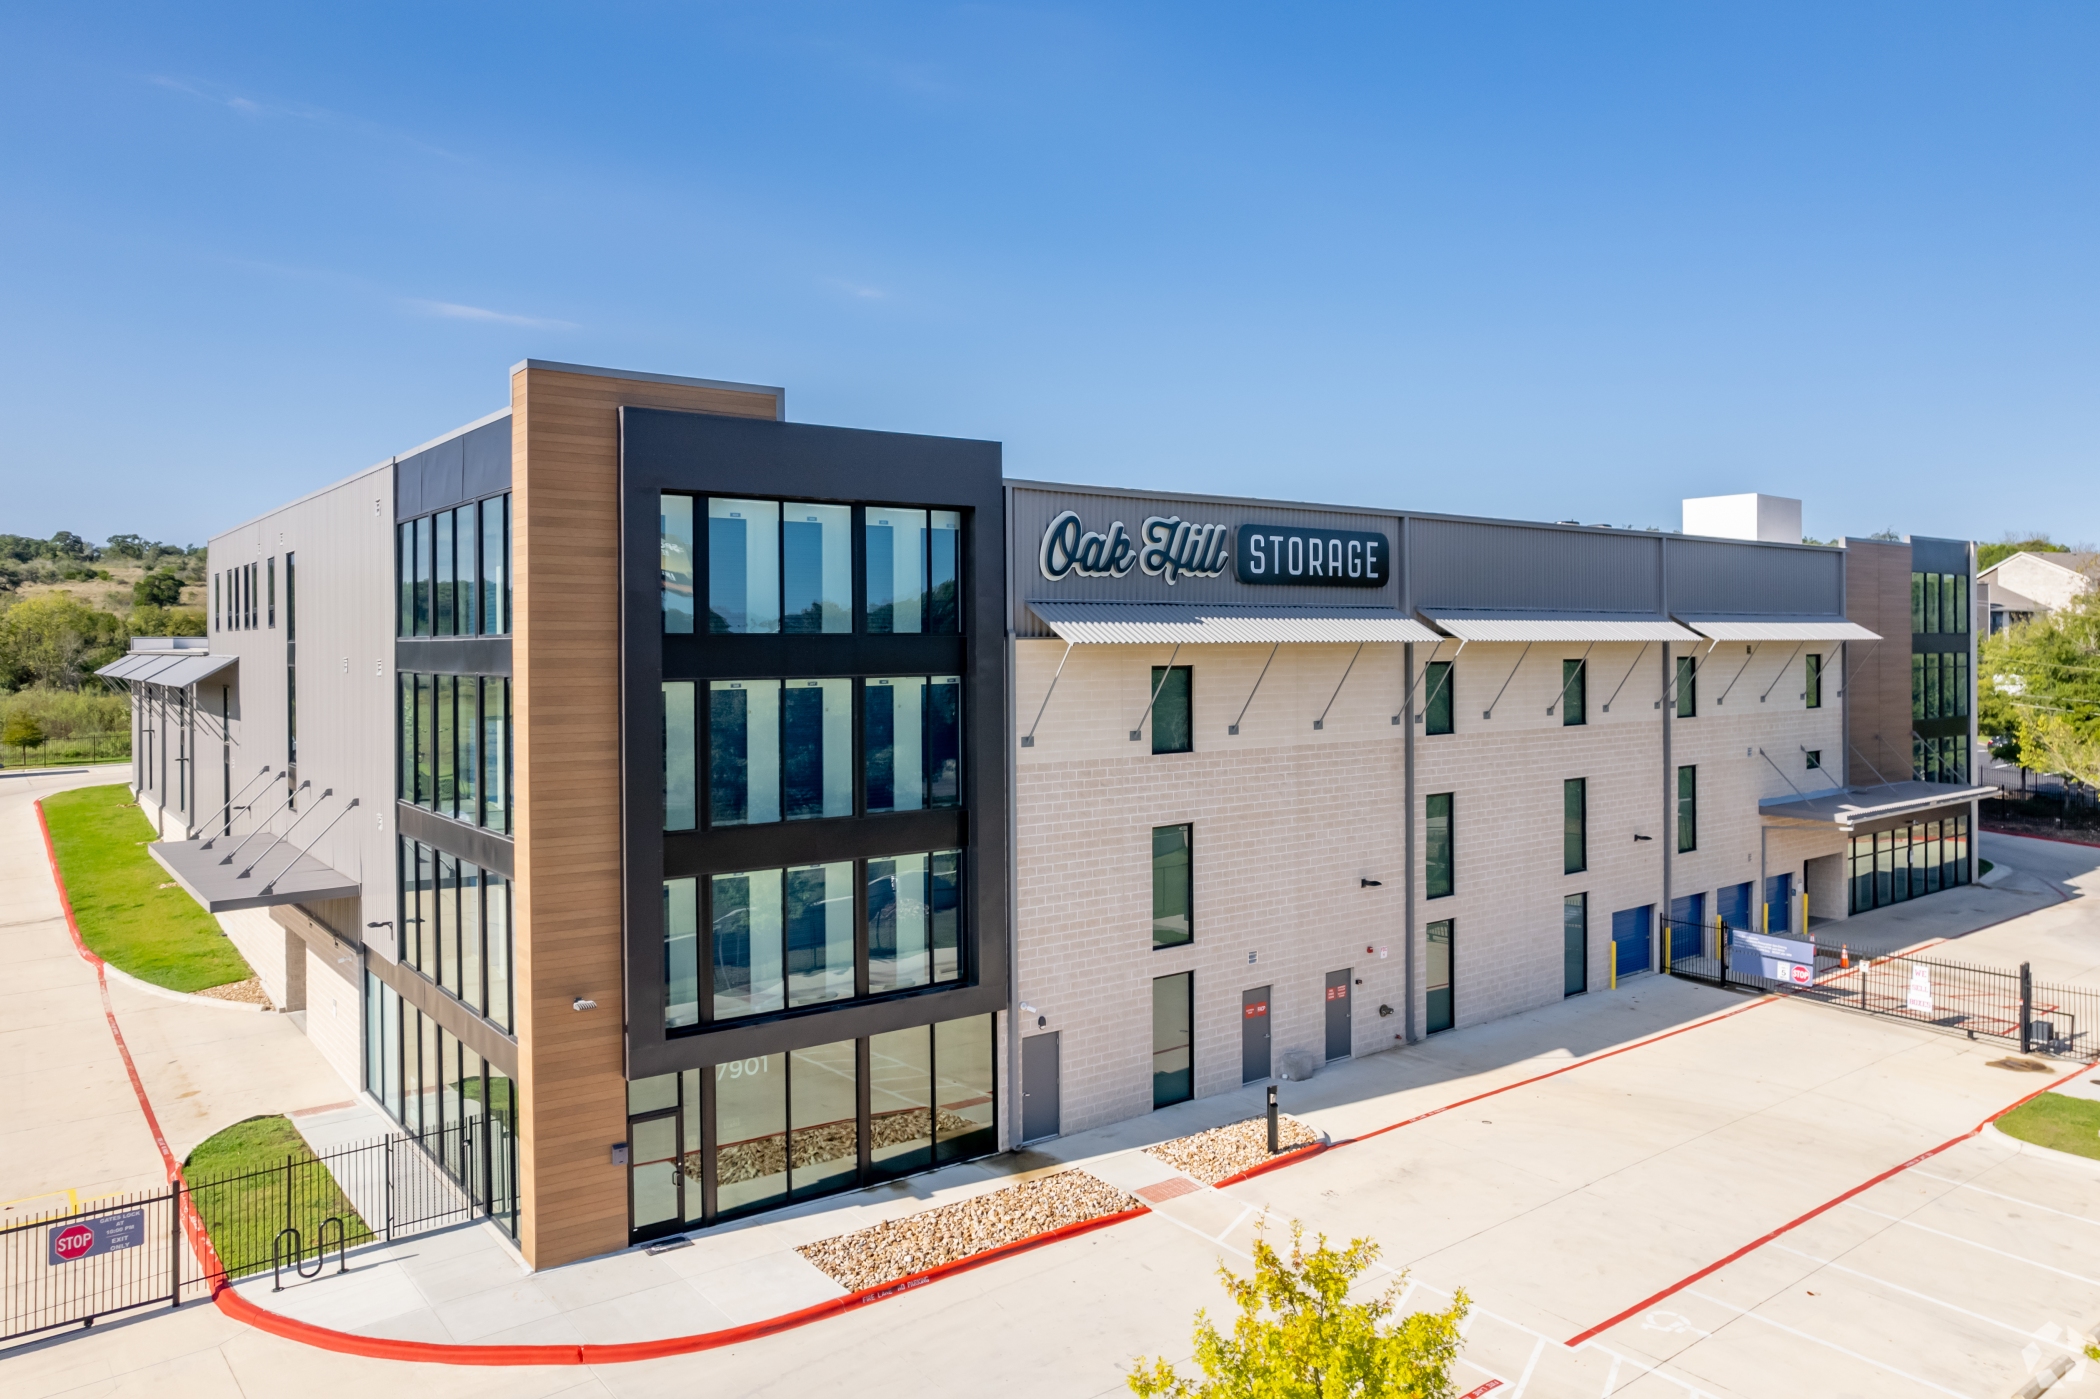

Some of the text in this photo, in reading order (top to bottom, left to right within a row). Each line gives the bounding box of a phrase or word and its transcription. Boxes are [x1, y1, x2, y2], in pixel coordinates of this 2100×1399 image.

[1041, 511, 1379, 586] Oak Hill STORAGE
[1792, 969, 1809, 980] STOP
[1915, 969, 1927, 978] WE
[717, 1055, 768, 1082] 7901
[99, 1210, 141, 1224] GATES LOCK
[57, 1232, 92, 1253] STOP
[111, 1235, 129, 1244] EXIT
[110, 1242, 130, 1251] ONLY
